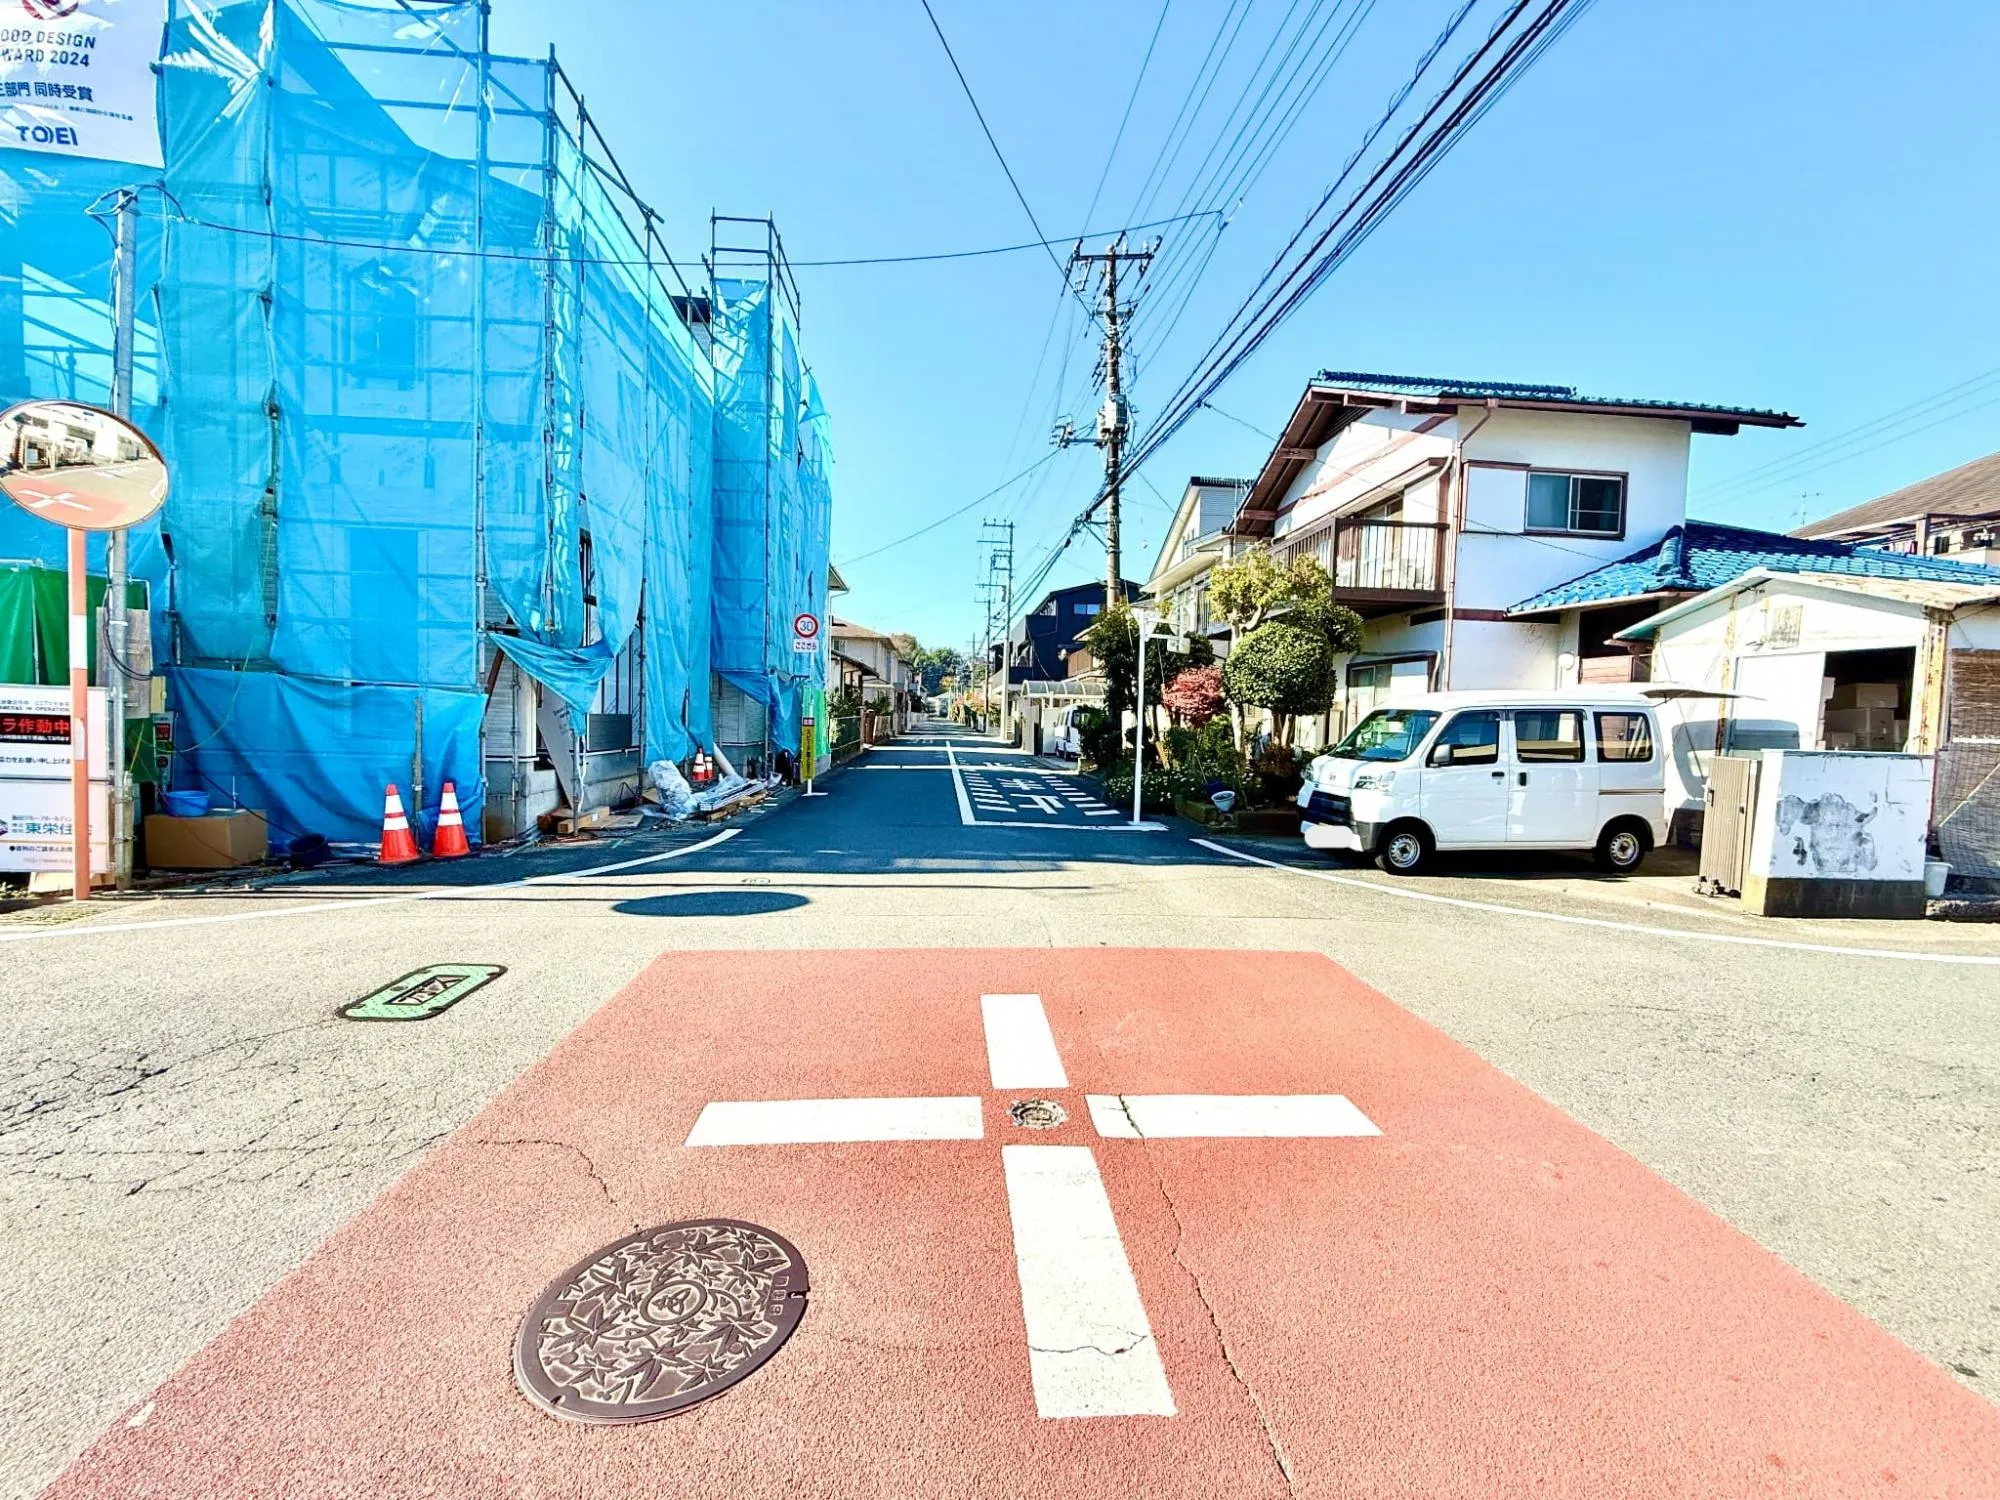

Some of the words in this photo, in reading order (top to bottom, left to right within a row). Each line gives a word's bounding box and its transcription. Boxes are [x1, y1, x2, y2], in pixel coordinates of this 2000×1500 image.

[36, 31, 96, 49] DESIGN
[49, 50, 90, 67] 2024
[34, 82, 94, 102] 同時受賞
[800, 620, 813, 631] 30
[3, 718, 69, 734] ラ作動中
[26, 822, 93, 836] 東栄住
